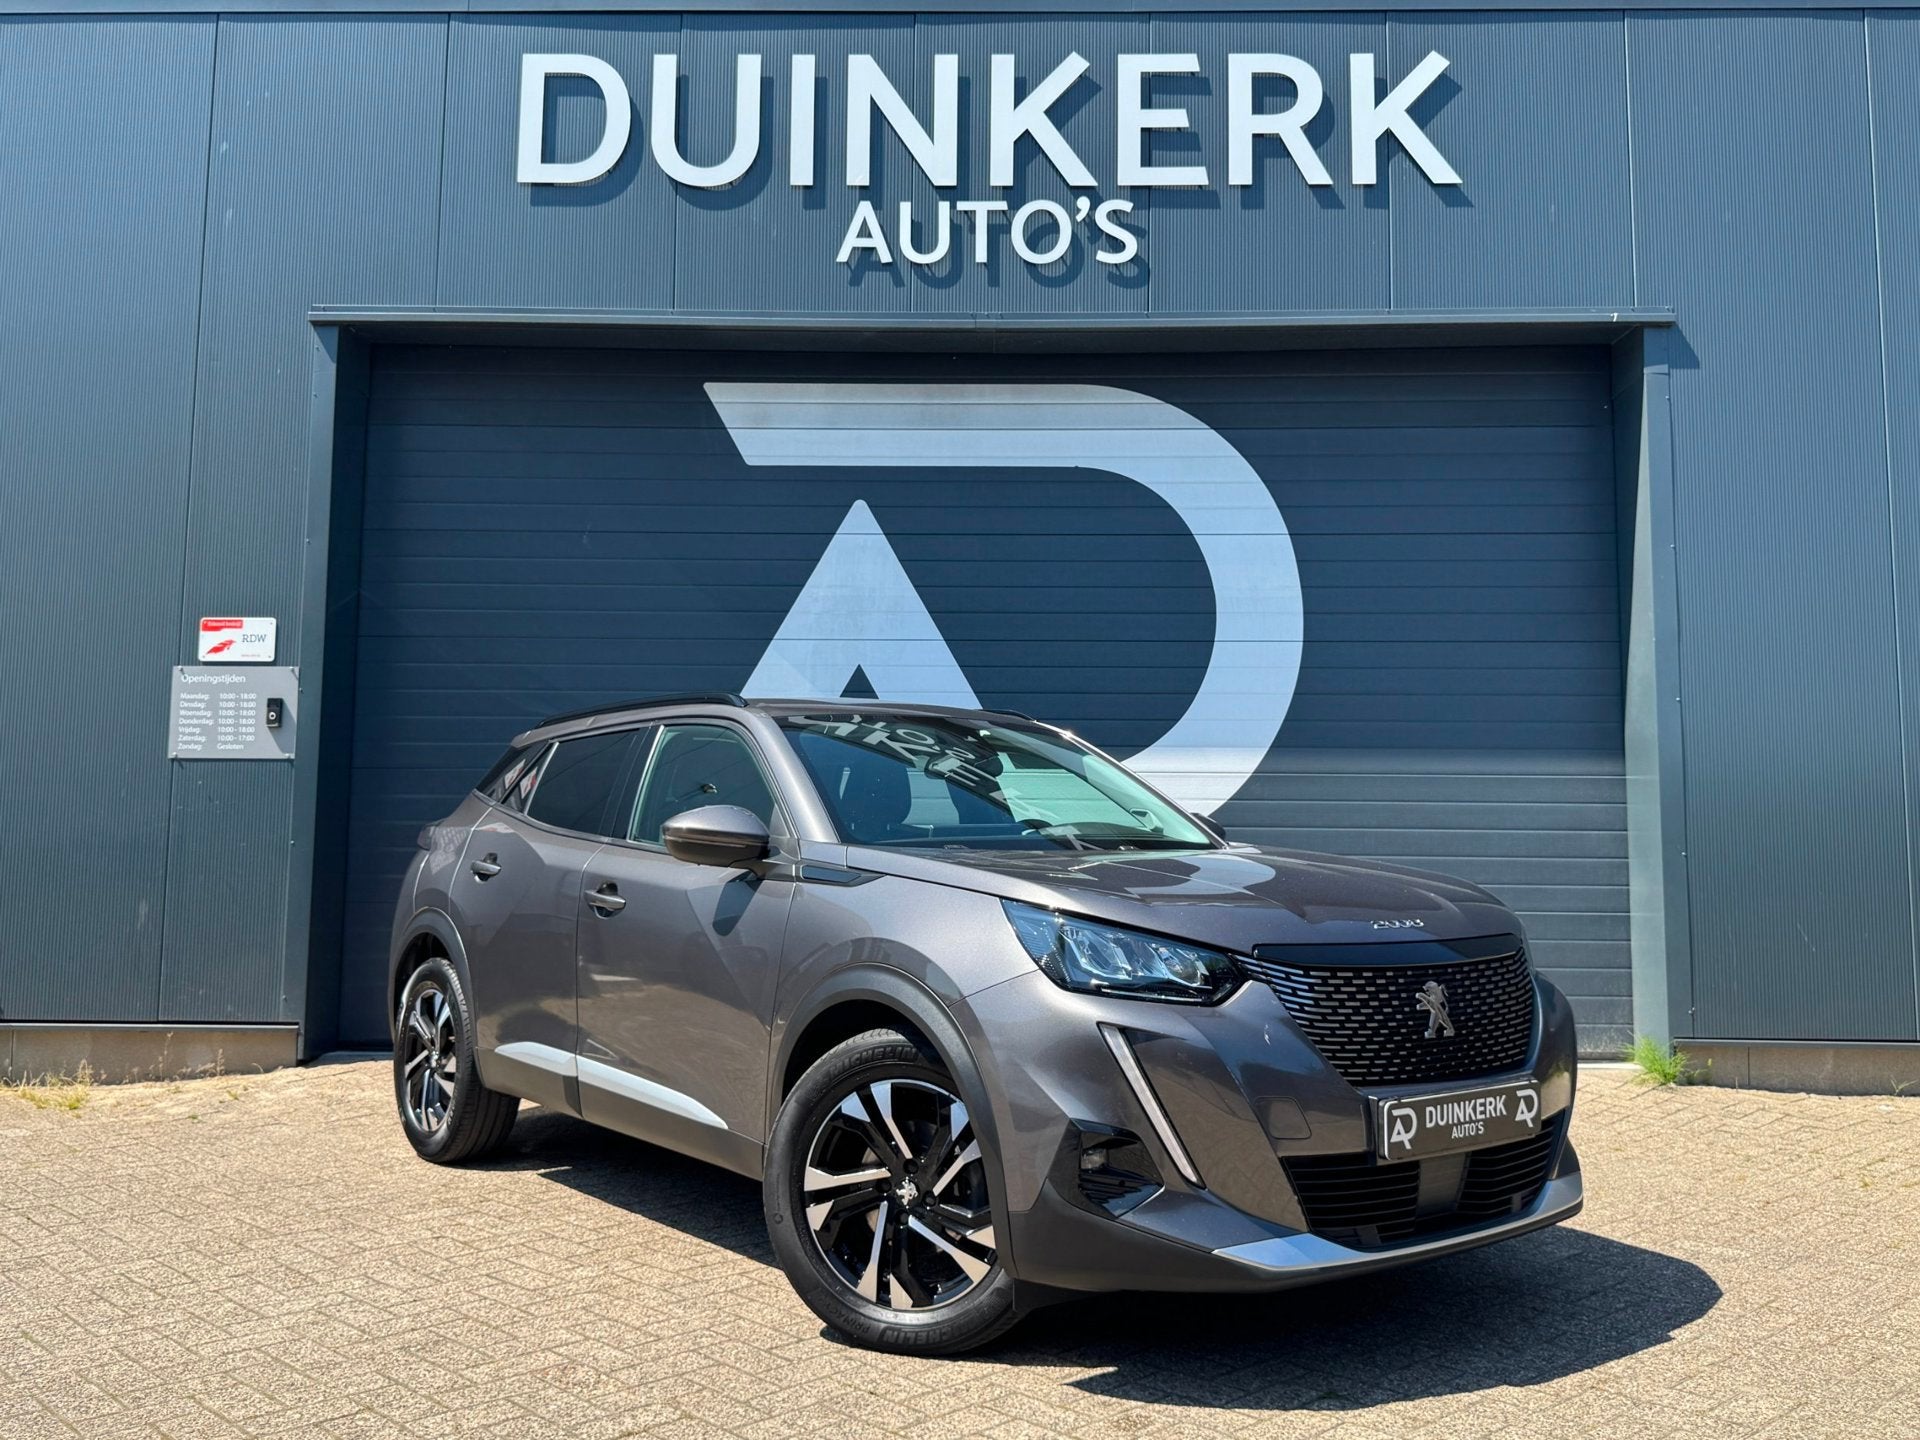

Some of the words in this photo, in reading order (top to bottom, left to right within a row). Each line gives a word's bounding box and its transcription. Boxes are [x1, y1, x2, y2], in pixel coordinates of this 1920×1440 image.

[516, 50, 1463, 188] DUINKERK
[836, 197, 1139, 266] AUTO'S
[242, 634, 267, 643] RDW
[181, 674, 246, 684] Openingstijden
[1425, 1094, 1507, 1128] DUINKERK
[1451, 1122, 1485, 1139] AUTO'S
